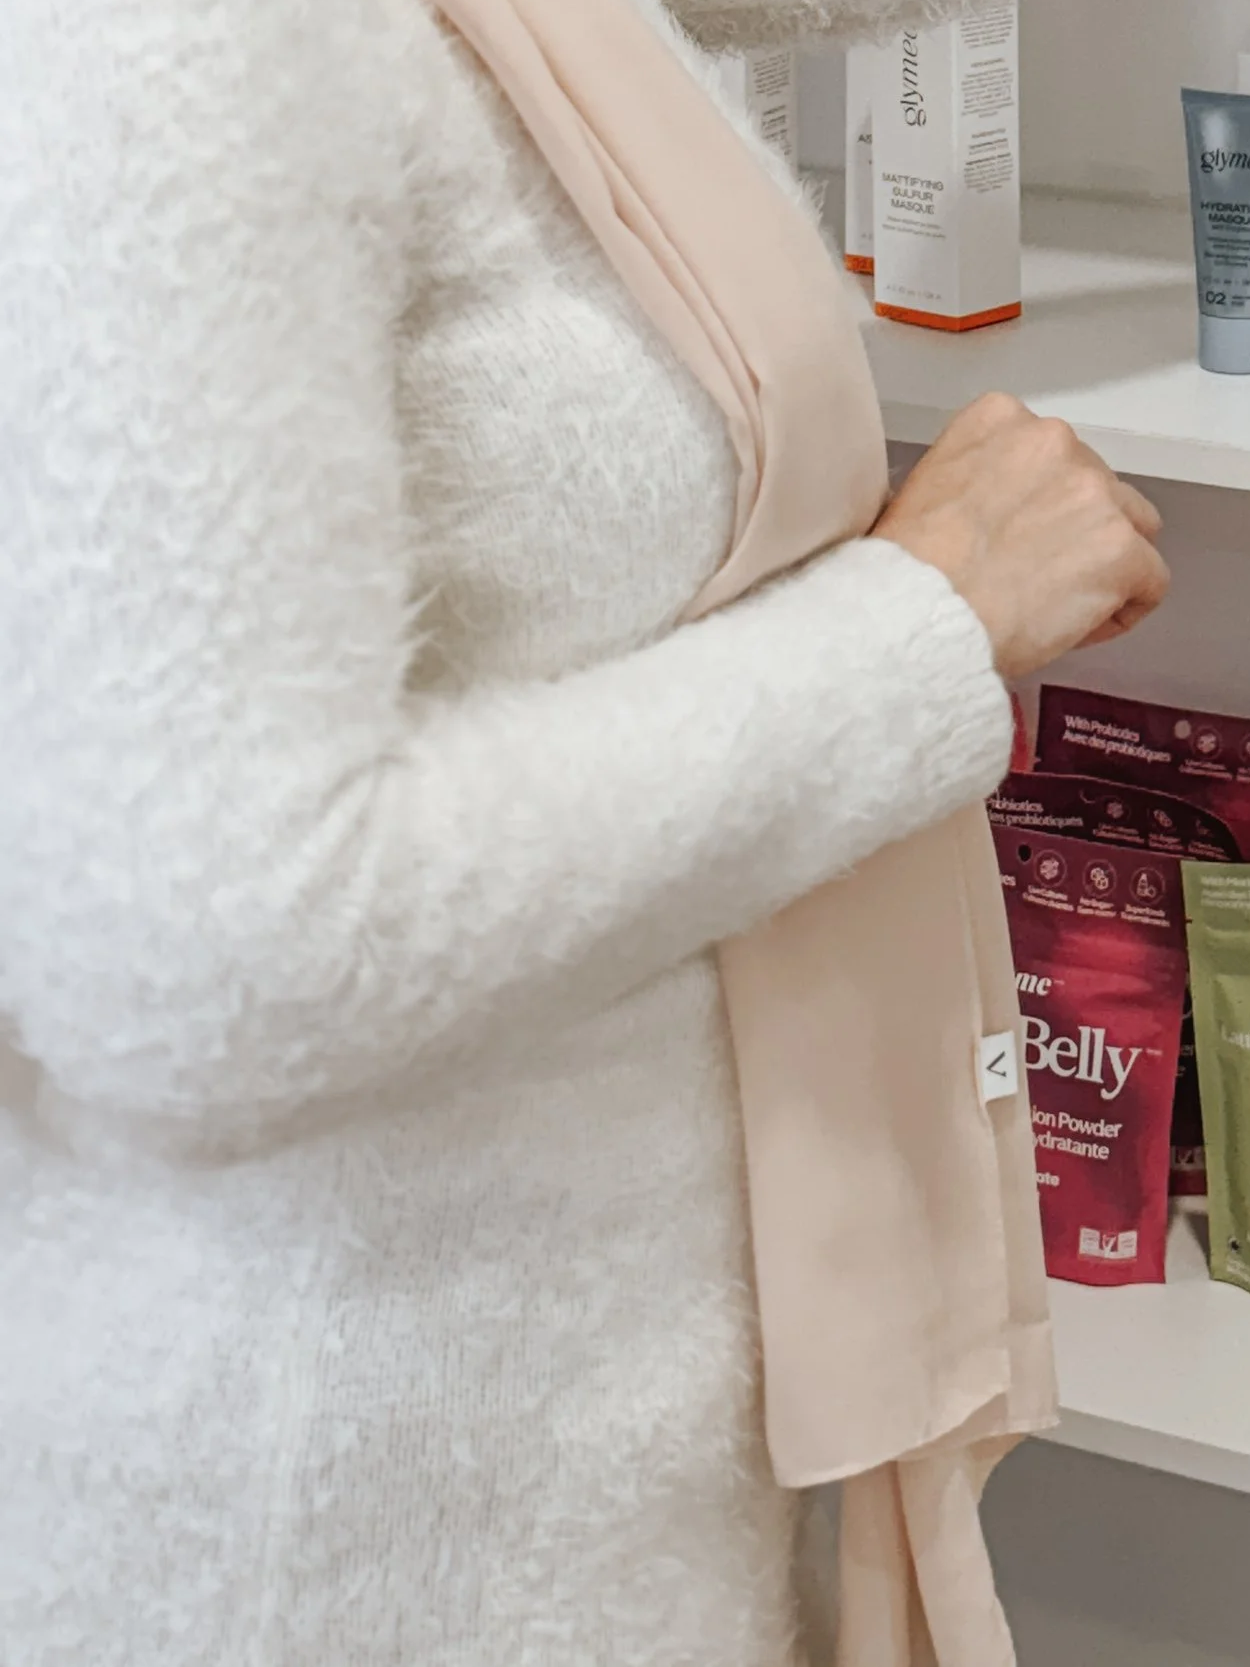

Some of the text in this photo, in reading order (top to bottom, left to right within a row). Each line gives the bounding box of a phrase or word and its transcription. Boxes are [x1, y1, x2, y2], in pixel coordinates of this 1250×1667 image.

[881, 171, 944, 191] MATTIFYING
[892, 186, 934, 202] SULFUR
[891, 199, 935, 215] MASQUE
[1205, 290, 1227, 306] 02
[1065, 715, 1140, 743] With Probiotics
[1062, 730, 1090, 746] Avec
[1105, 741, 1172, 764] probiotiques
[1005, 813, 1084, 829] probiotiques
[1058, 1112, 1124, 1139] Powder
